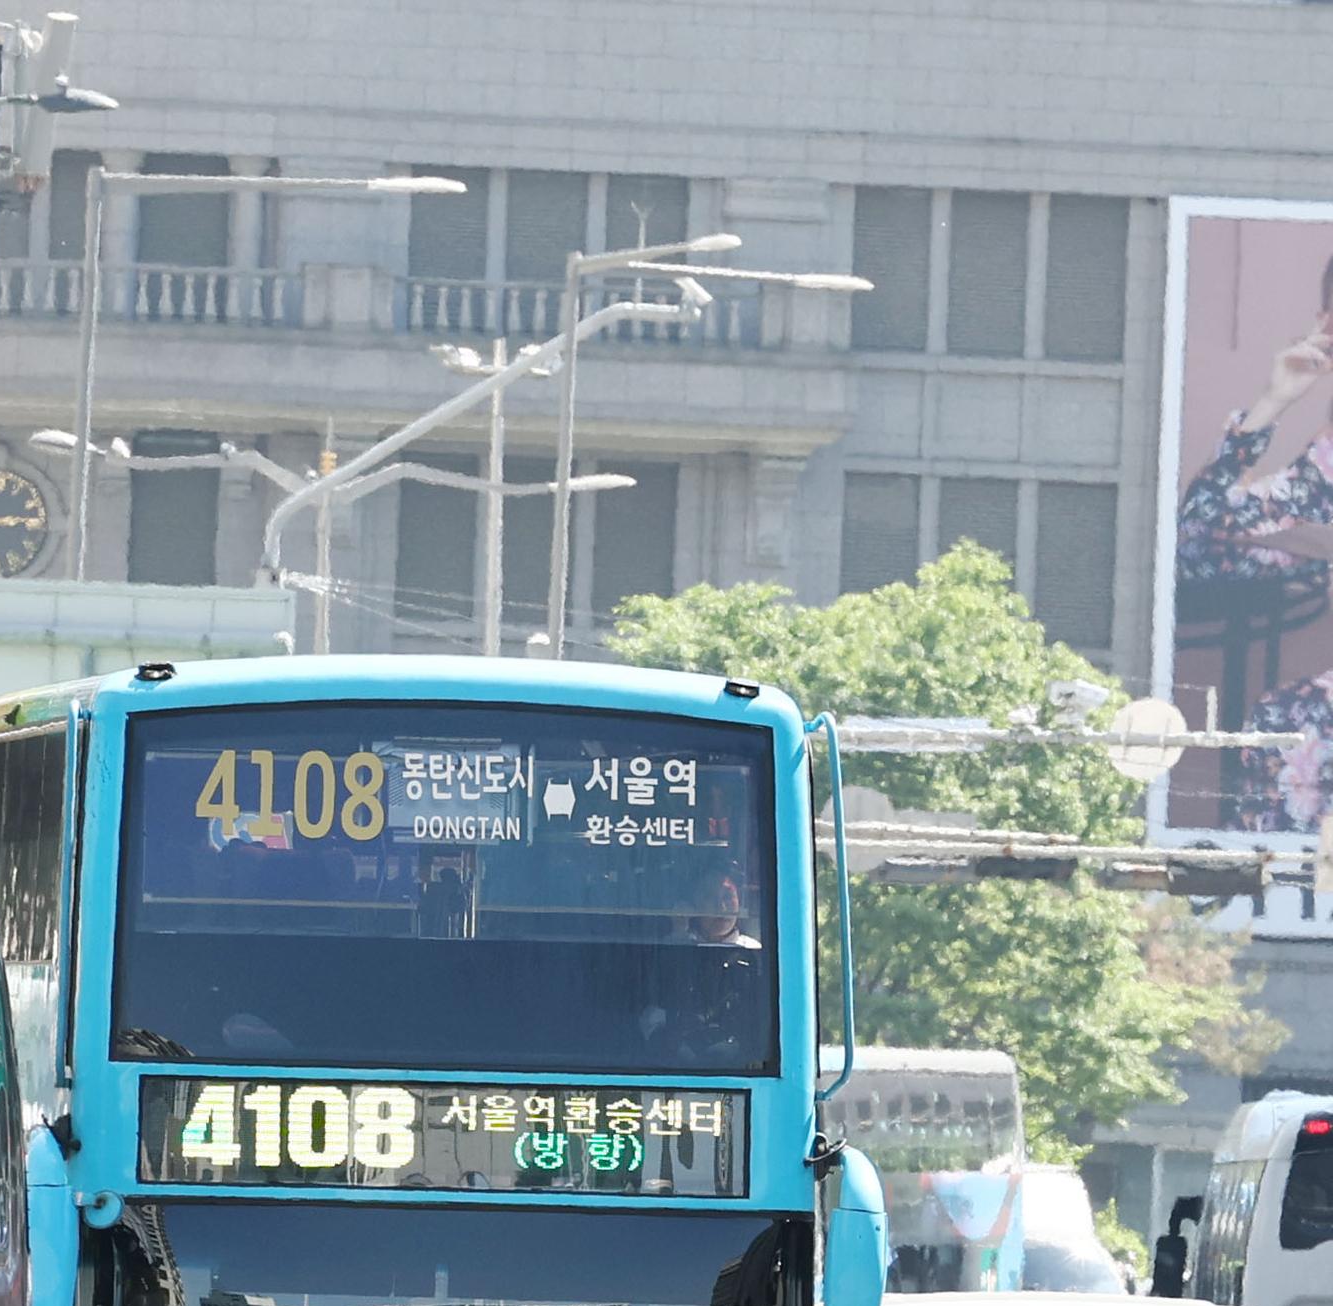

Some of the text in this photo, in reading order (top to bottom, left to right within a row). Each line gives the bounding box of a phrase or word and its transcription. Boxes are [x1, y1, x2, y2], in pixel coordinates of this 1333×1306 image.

[195, 749, 384, 840] 4108
[402, 752, 534, 800] 동탄신도시
[584, 756, 697, 807] 서울역
[414, 815, 520, 841] DONGTAN
[586, 814, 695, 846] 환승센터
[182, 1085, 414, 1168] 4108
[441, 1094, 720, 1138] 서울역환승센터
